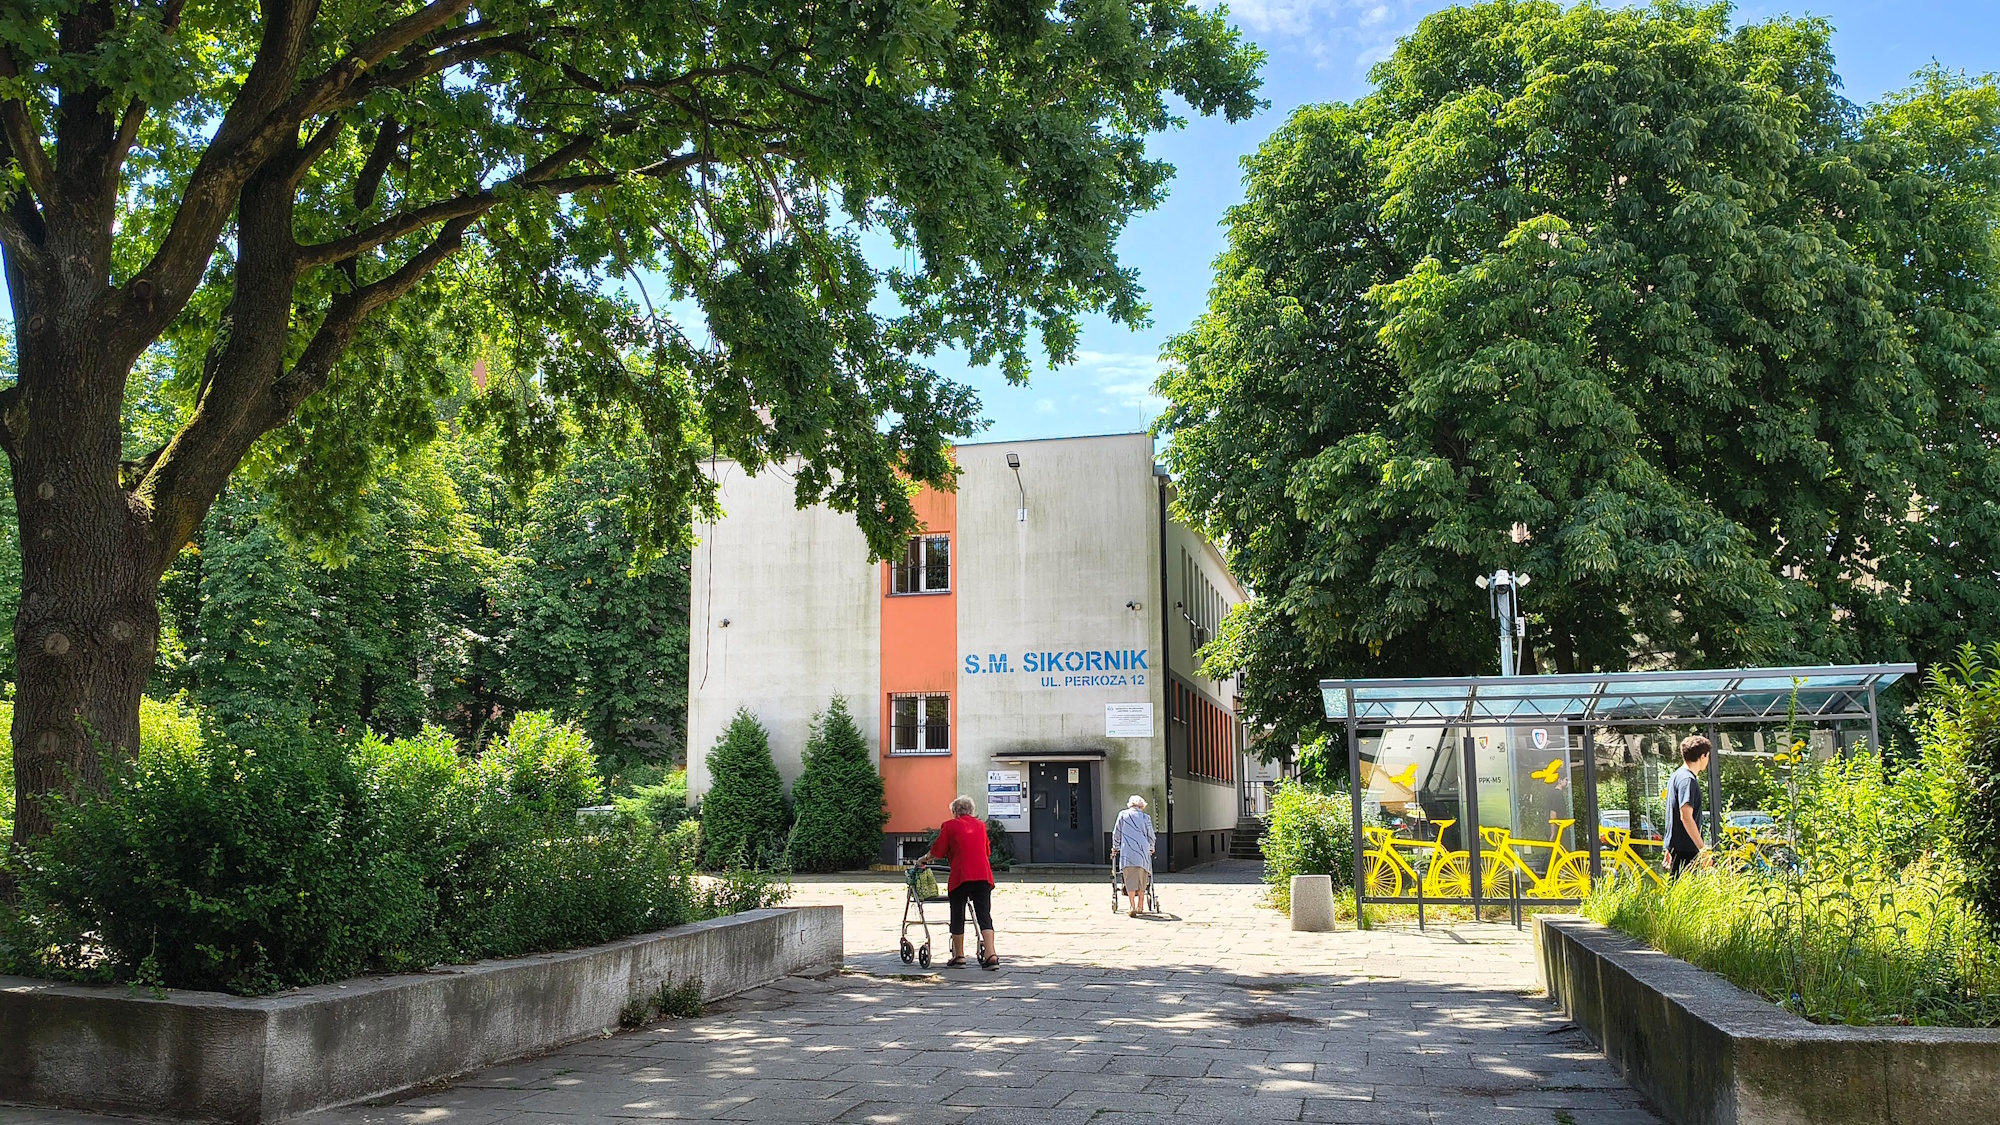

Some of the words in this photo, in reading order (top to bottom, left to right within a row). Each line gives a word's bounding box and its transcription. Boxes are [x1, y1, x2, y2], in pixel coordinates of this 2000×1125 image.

[965, 654, 1014, 674] S.M.
[1023, 650, 1148, 672] SIKORNIK
[1041, 677, 1061, 687] UL.
[1065, 675, 1127, 686] PERKOZA
[1131, 674, 1145, 685] 12
